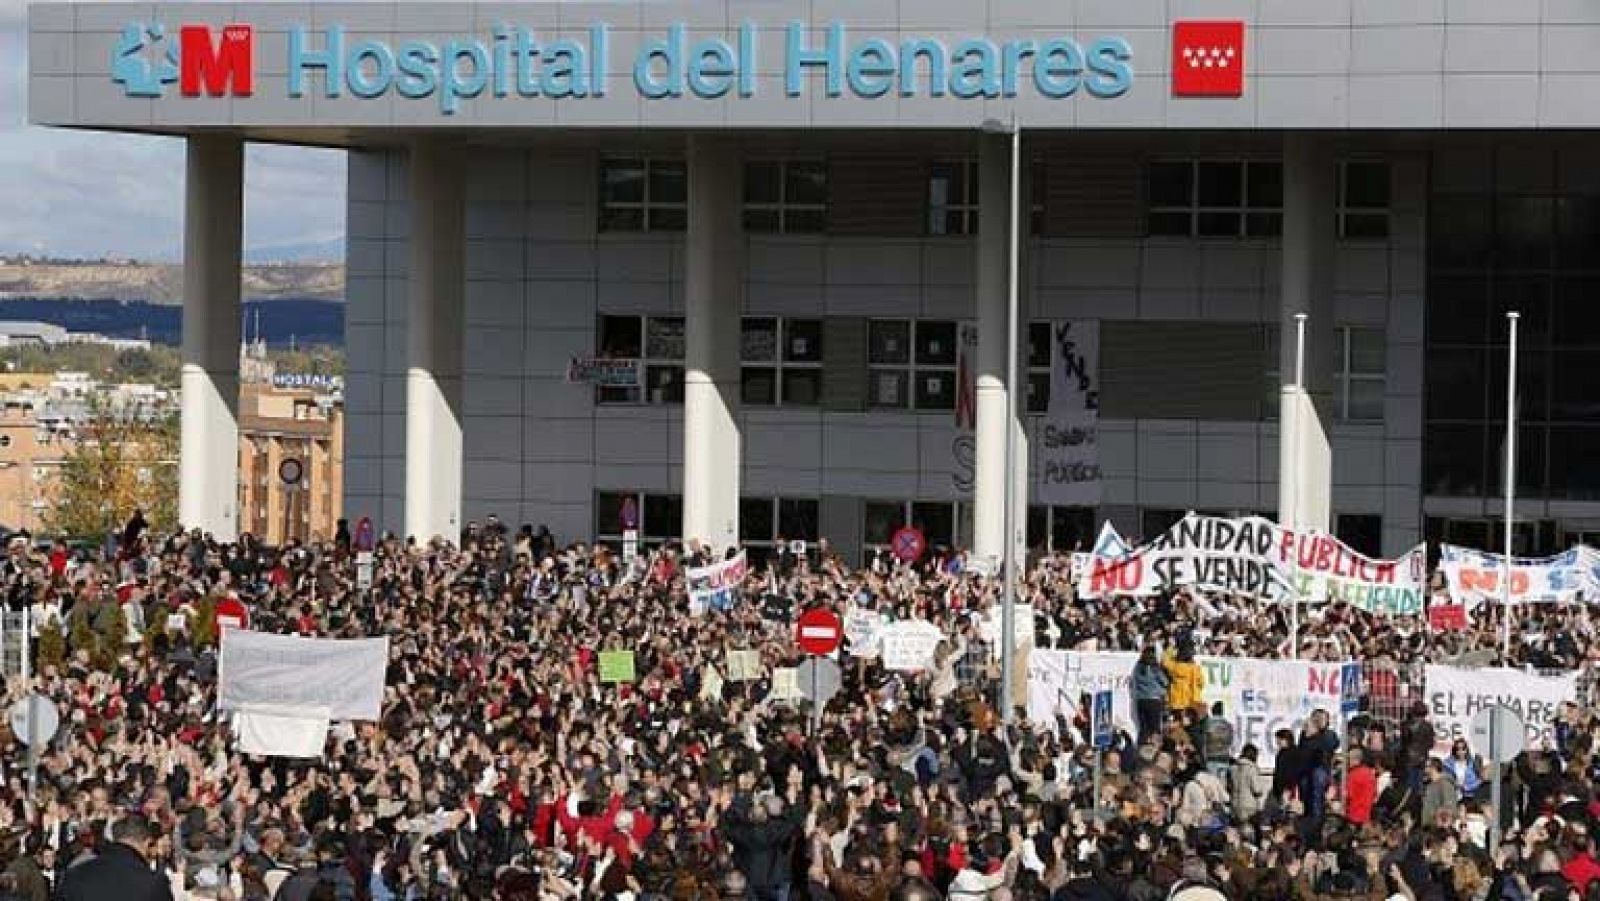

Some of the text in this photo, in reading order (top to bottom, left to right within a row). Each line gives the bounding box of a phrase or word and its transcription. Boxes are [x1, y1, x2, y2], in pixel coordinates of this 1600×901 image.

[285, 18, 1135, 114] Hospital del Henares
[1149, 517, 1273, 556] ANIDAD
[1090, 553, 1143, 593] NO
[1153, 556, 1185, 592] SE
[1194, 555, 1277, 599] VENDE
[1202, 661, 1232, 688] TU
[1241, 689, 1271, 712] ES
